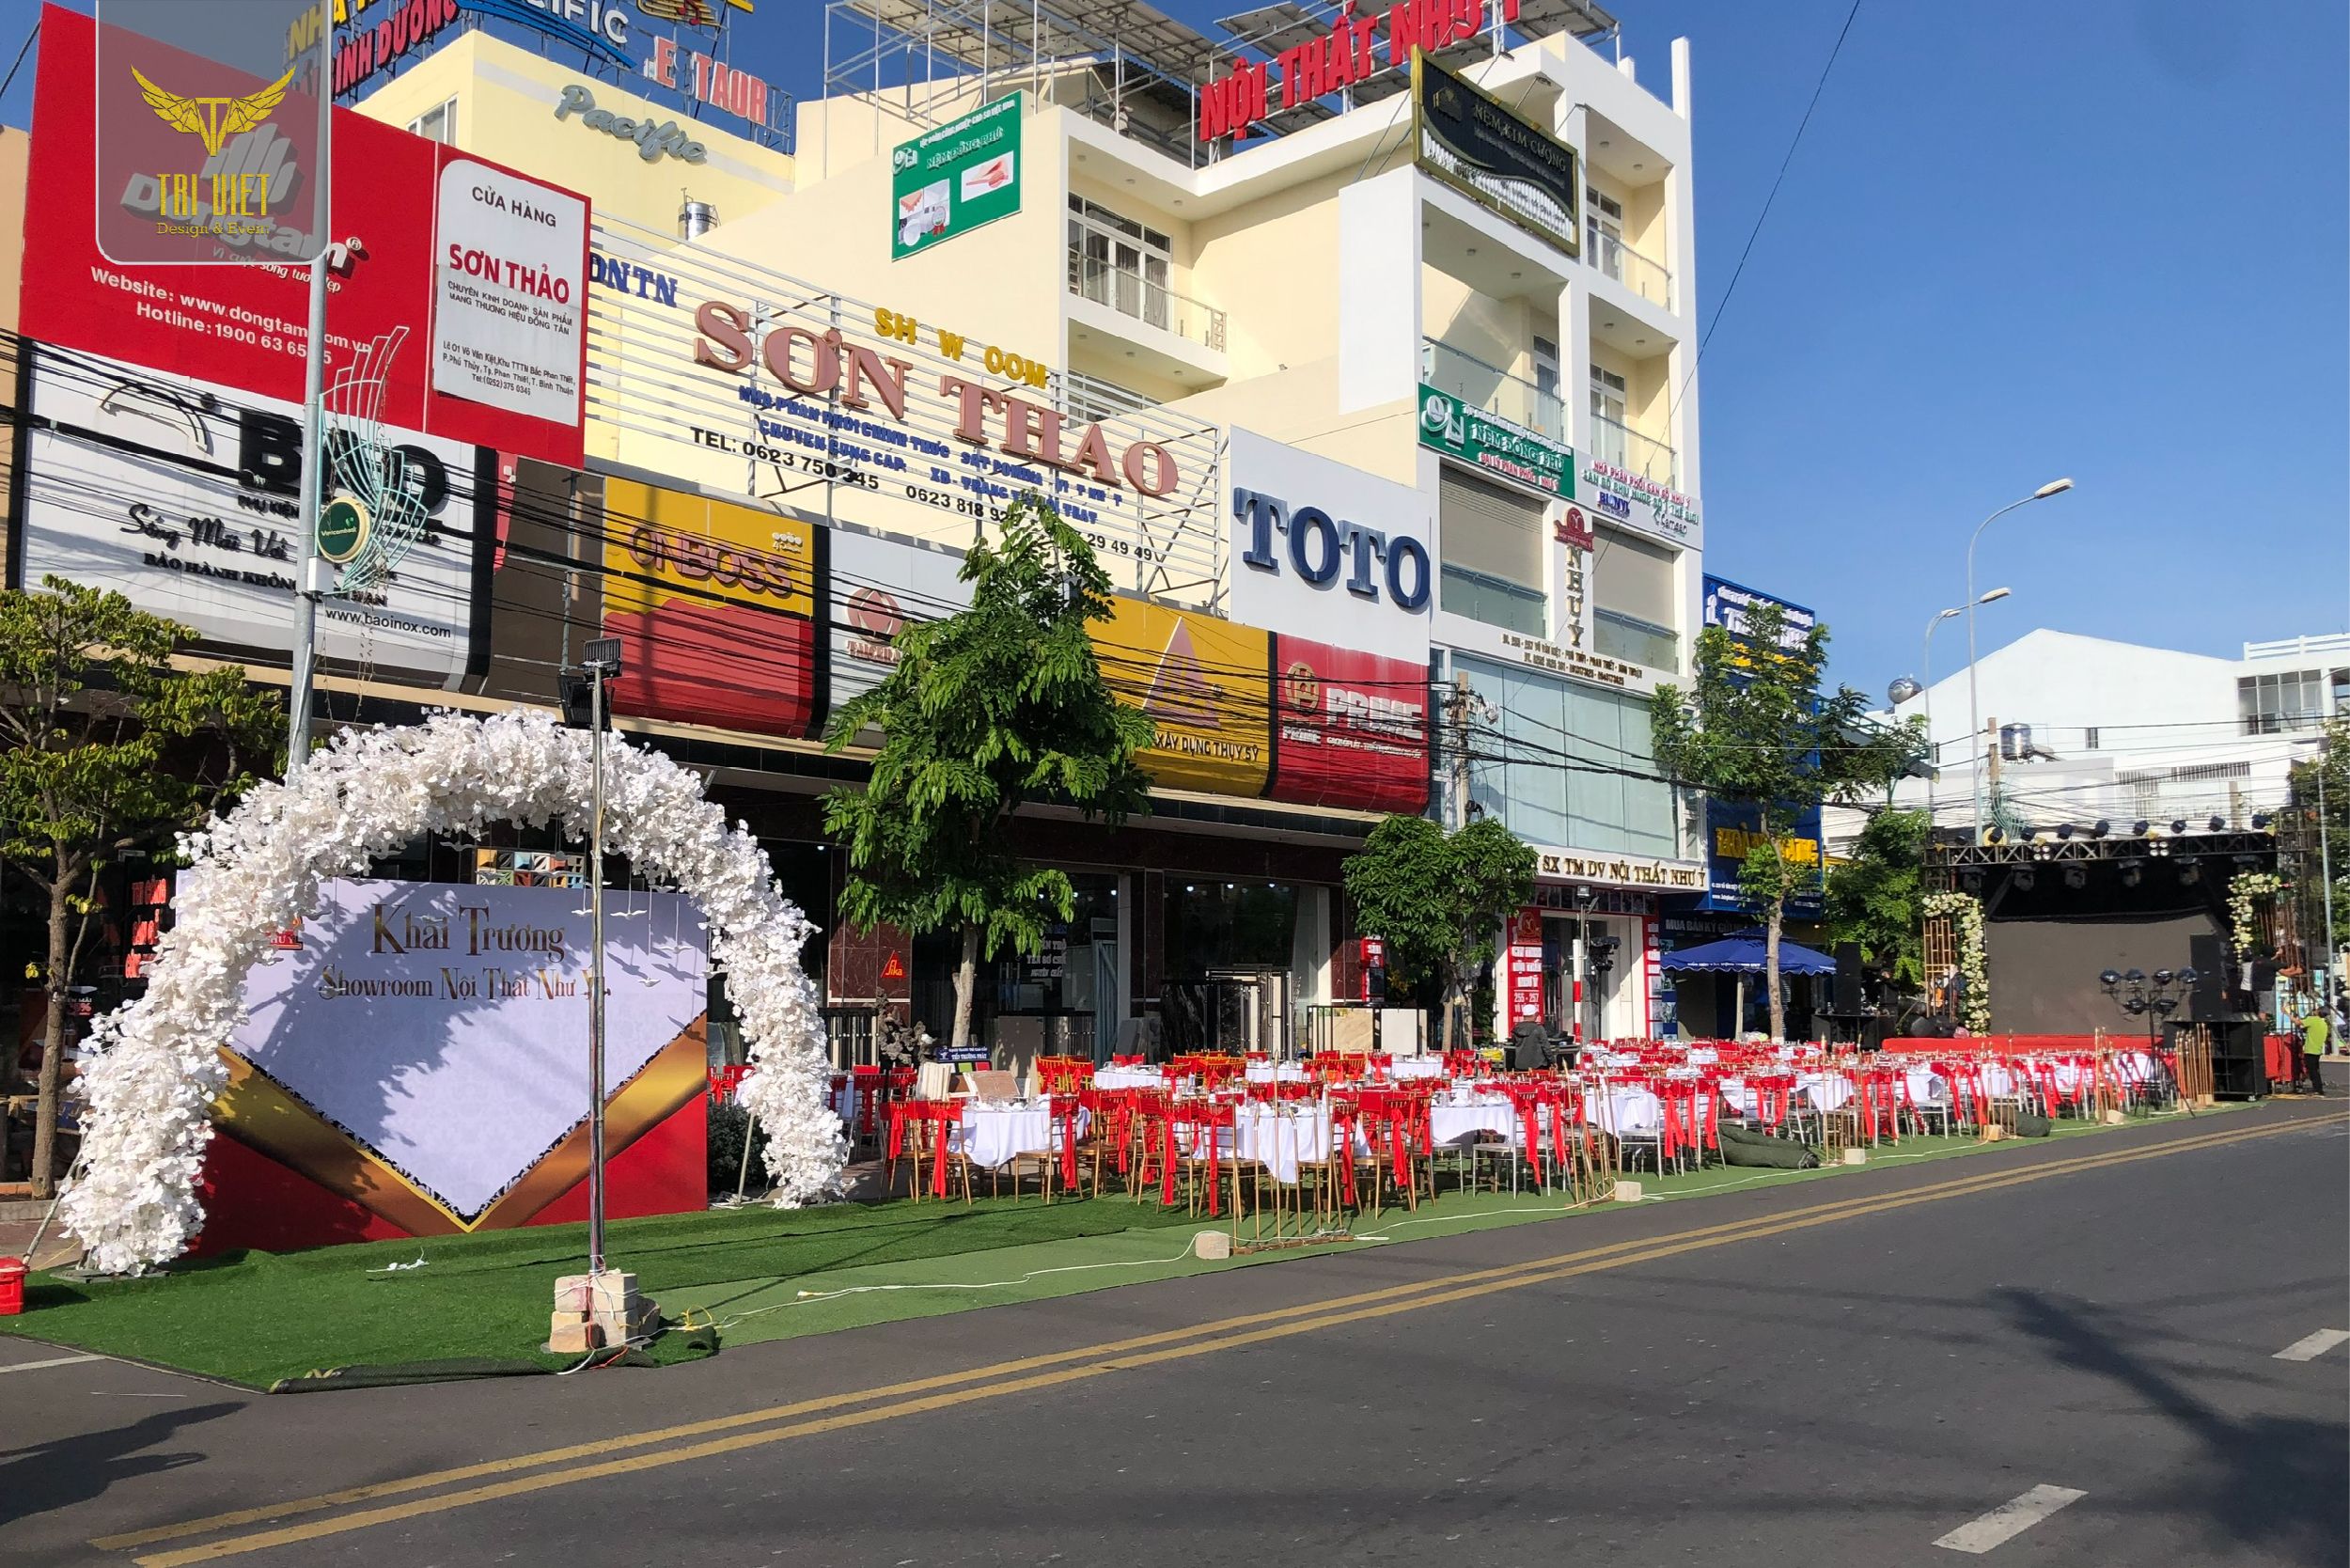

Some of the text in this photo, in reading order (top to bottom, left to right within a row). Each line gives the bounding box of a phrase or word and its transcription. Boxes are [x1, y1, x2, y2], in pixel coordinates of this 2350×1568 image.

[332, 29, 375, 96] ÌNH
[554, 85, 708, 164] Pacific
[1199, 55, 1266, 141] NỘI
[472, 185, 556, 227] CỬA HÀNG
[449, 243, 570, 304] SƠN THẢO
[90, 266, 372, 353] Website: www.dongtamom.vn
[261, 335, 283, 352] 63
[287, 340, 307, 359] 65
[694, 300, 914, 420] SƠN
[690, 427, 737, 453] TEL:
[743, 441, 794, 466] 0623
[906, 485, 950, 508] 0623
[956, 497, 984, 517] 818
[1111, 540, 1129, 556] 49
[1134, 546, 1152, 561] 49
[1233, 487, 1431, 608] TOTO
[243, 572, 297, 591] KHÔN
[326, 609, 451, 639] www.baoinox.com
[1326, 687, 1423, 740] PRIME
[1543, 855, 1560, 874] SX
[1564, 857, 1585, 876] TM
[1587, 860, 1606, 879] DV
[1609, 859, 1630, 885] NỘI
[1634, 861, 1668, 885] THẤT
[370, 903, 565, 964] Khai Trương
[320, 963, 432, 999] Showroom
[439, 967, 476, 1001] Nội
[482, 966, 529, 1000] Thất
[535, 967, 576, 1000] Như
[885, 960, 902, 975] Sika
